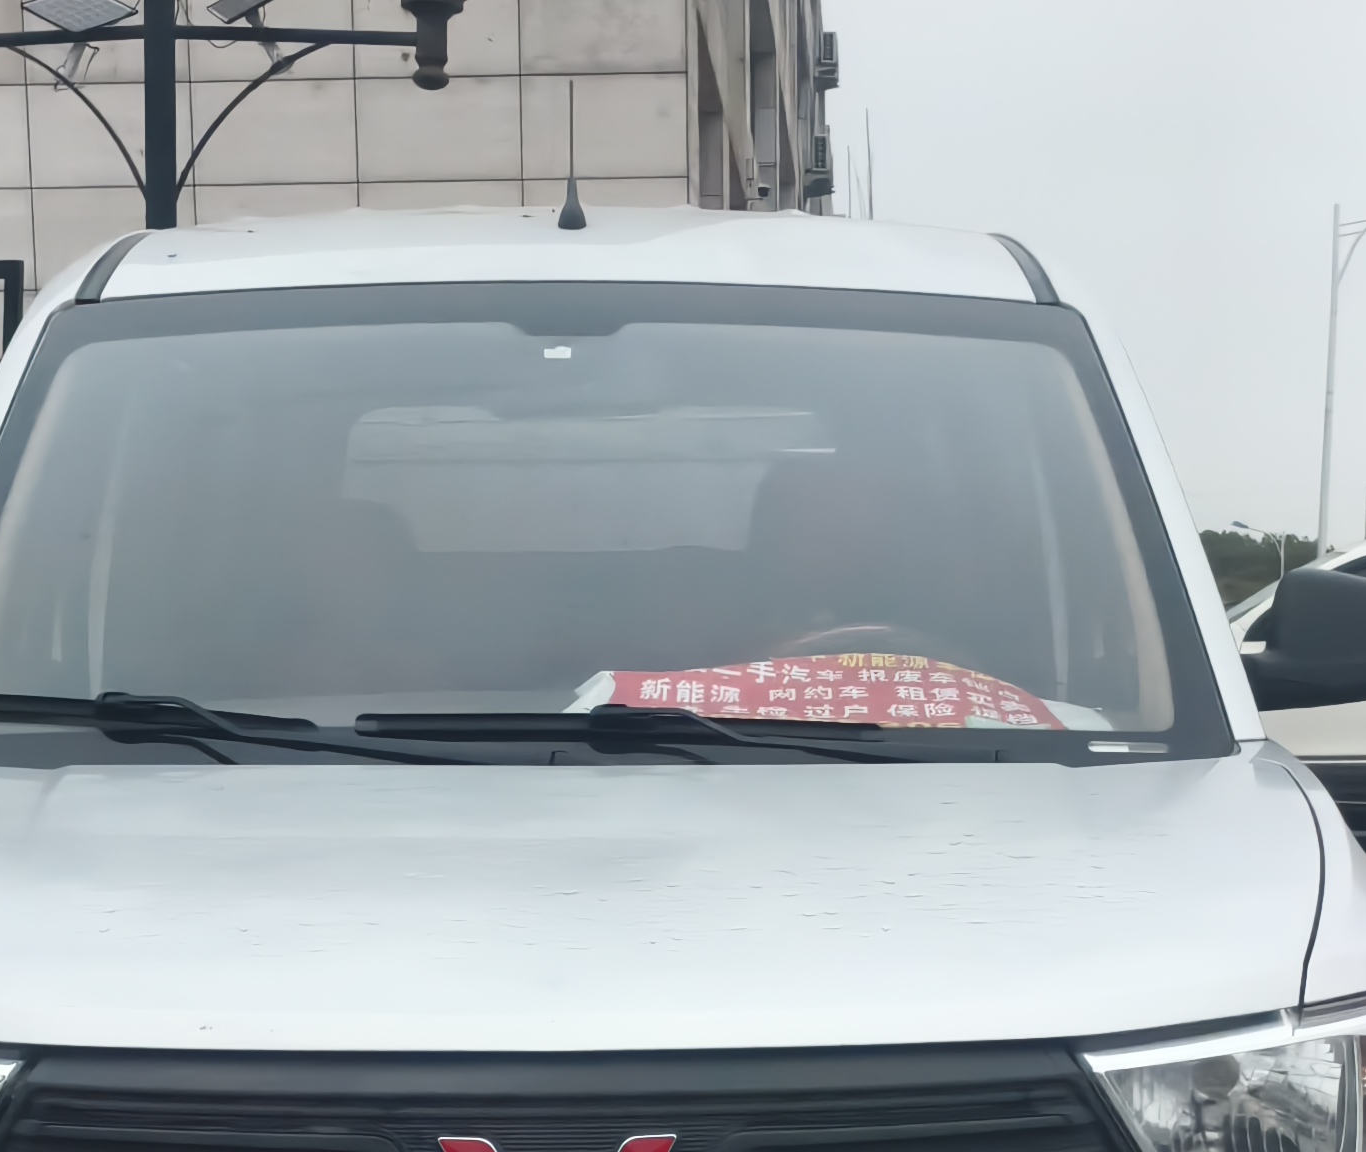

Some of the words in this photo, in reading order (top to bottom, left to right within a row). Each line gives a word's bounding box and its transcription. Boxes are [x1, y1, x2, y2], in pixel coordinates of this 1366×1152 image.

[858, 669, 957, 684] 报废车
[640, 677, 741, 704] 新能源
[769, 685, 869, 701] 网约车
[895, 686, 961, 701] 租赁
[804, 704, 868, 719] 过户
[887, 703, 957, 718] 保险
